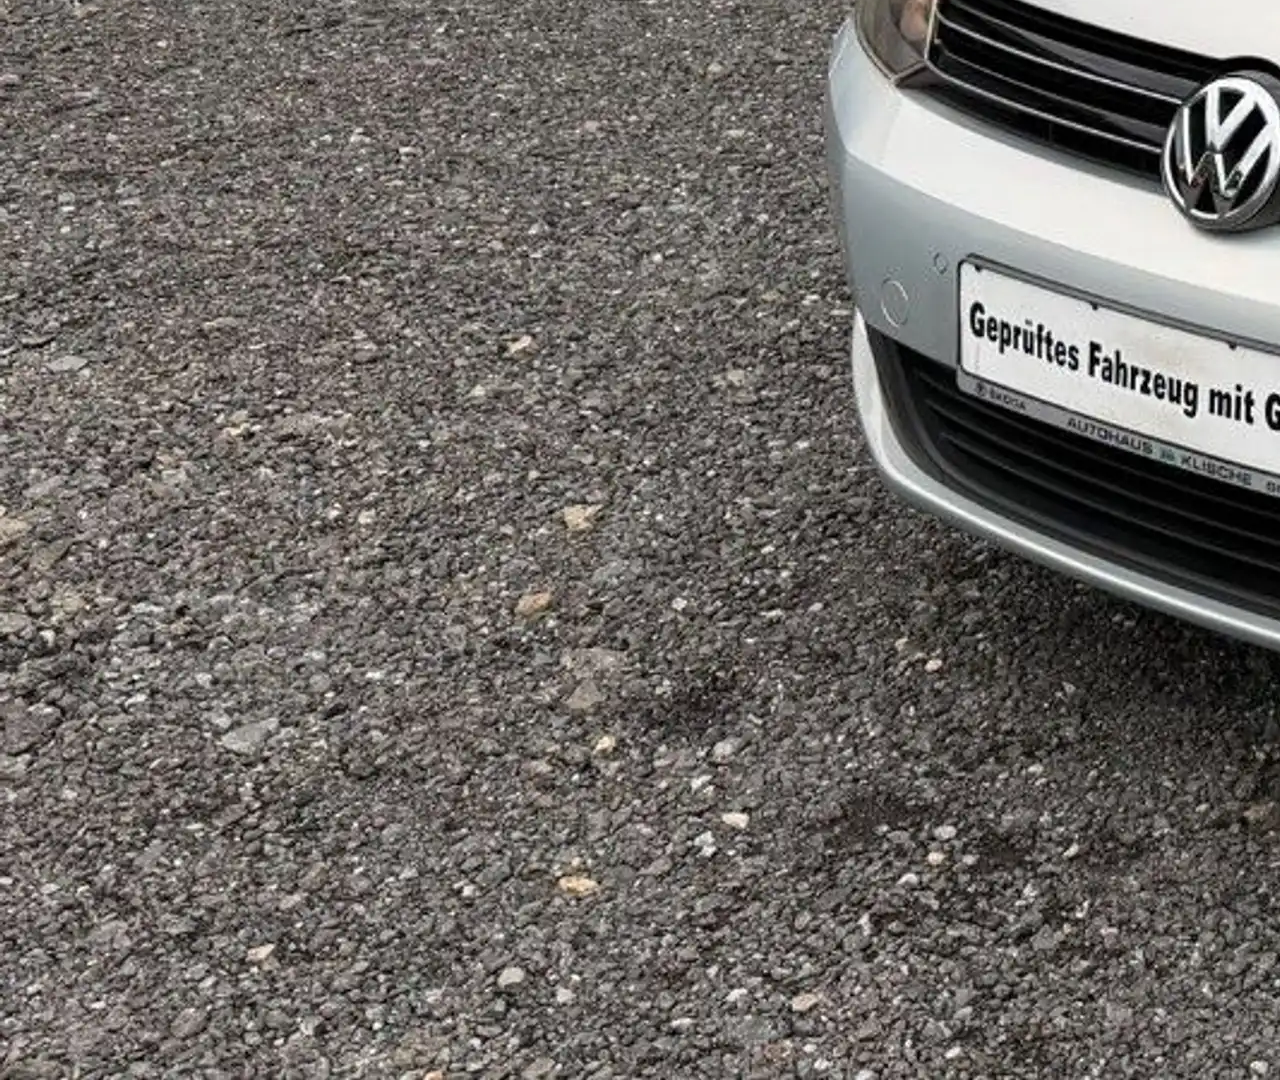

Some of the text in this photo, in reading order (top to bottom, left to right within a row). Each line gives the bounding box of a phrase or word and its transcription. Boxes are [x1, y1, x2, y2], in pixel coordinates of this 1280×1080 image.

[969, 300, 1080, 371] Geprüftes
[1088, 340, 1198, 418] Fahrzeug
[1208, 384, 1255, 425] mit
[1066, 417, 1153, 454] AUTOHAUS
